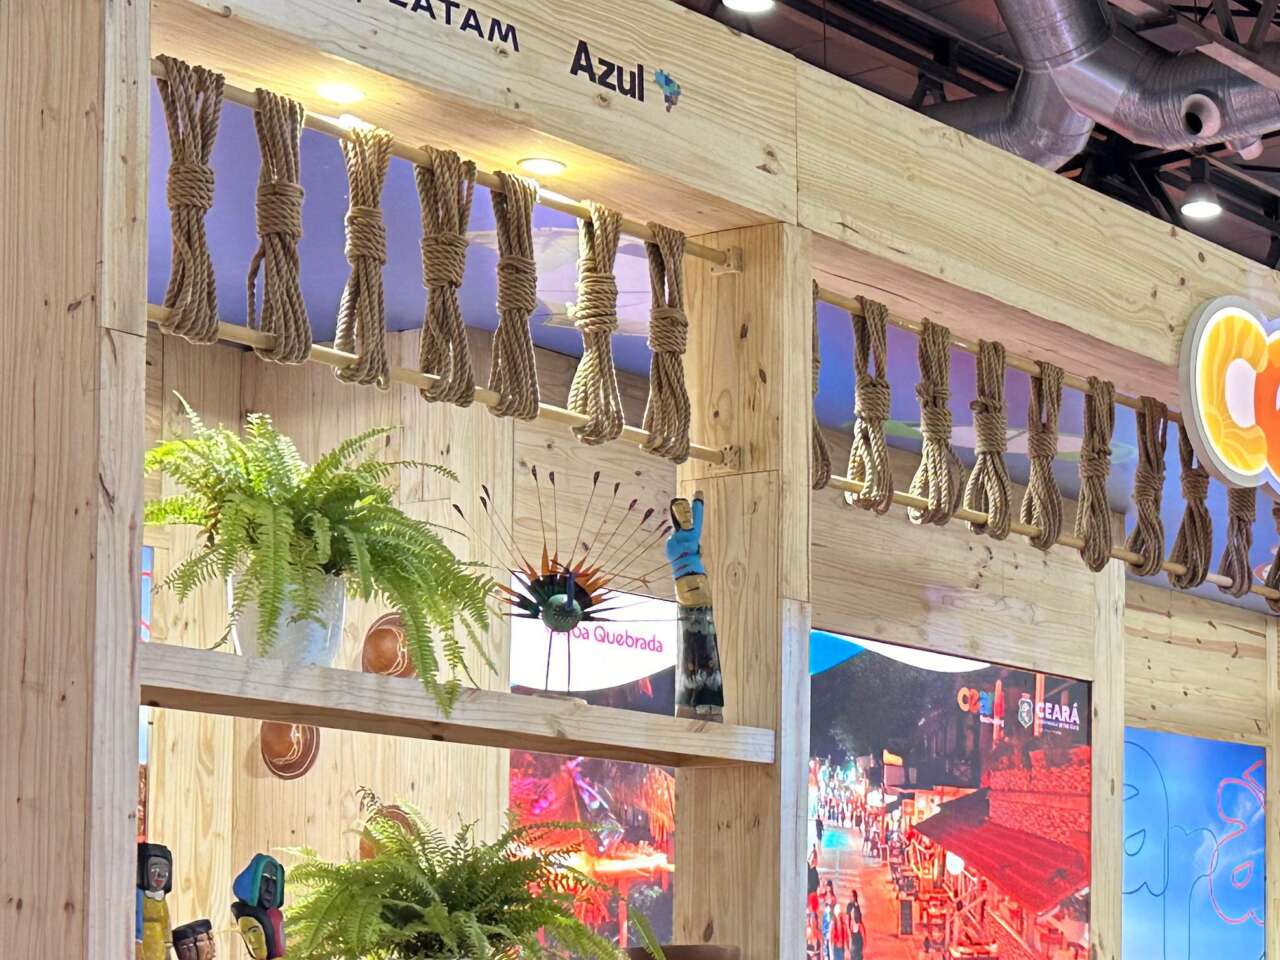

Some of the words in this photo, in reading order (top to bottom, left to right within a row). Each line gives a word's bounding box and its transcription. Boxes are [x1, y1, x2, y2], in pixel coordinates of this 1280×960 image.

[389, 0, 519, 52] ATAM
[569, 39, 645, 102] Azul
[593, 624, 664, 653] Quebrada
[1035, 702, 1080, 724] CEARÁ
